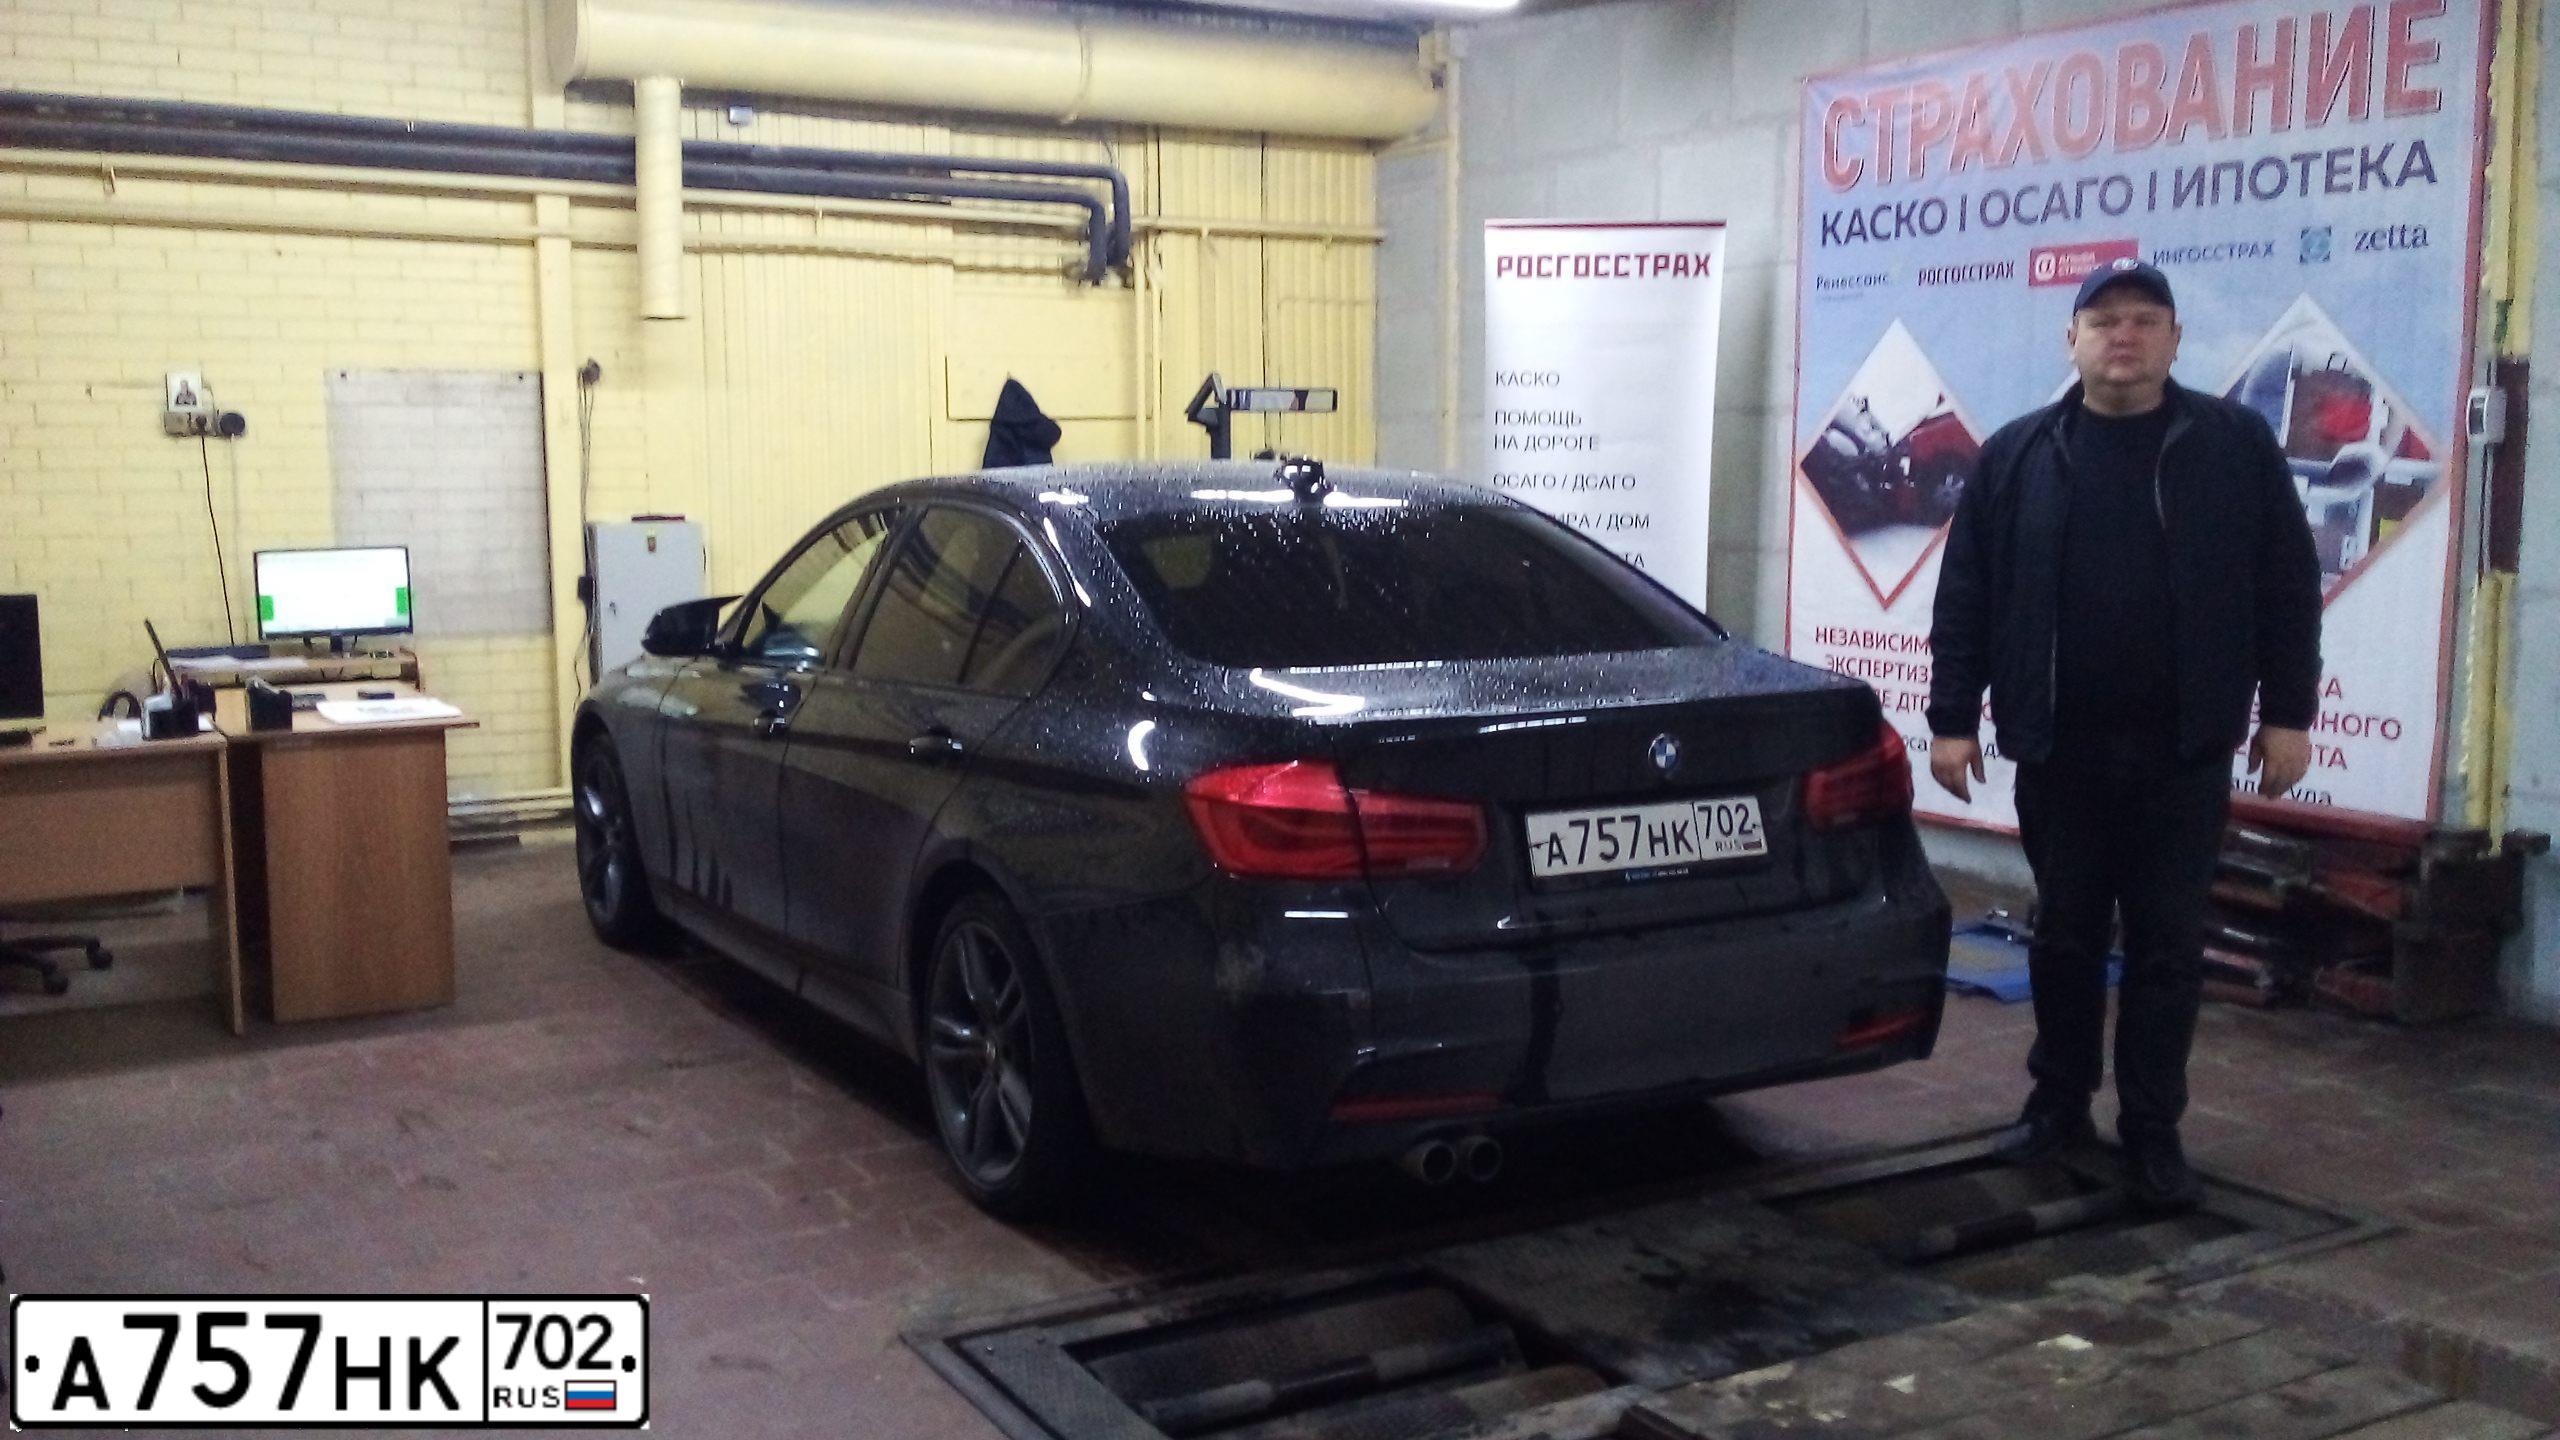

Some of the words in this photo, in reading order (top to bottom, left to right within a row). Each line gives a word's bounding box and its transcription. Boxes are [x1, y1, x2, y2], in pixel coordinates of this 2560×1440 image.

[1821, 0, 2446, 193] СТРАХОВАНИЕ
[1820, 197, 1948, 248] КАСКО
[1979, 176, 2133, 229] ОСАГО
[2171, 138, 2438, 208] ИПОТЕКА
[2354, 223, 2430, 252] zetta
[1497, 252, 1711, 279] РОСГОССТРАХ
[2152, 239, 2275, 267] ИНГОССТРАХ
[1918, 260, 2014, 287] РОСГОССТРАХ
[1494, 369, 1560, 388] КАСКО
[1494, 408, 1582, 429] ПОМОЩЬ
[1493, 433, 1519, 452] НА
[1523, 434, 1600, 454] ДОРОГЕ
[1493, 471, 1556, 490] ОСАГО
[1571, 473, 1636, 493] ДСАГО
[1606, 513, 1650, 532] ДОМ
[1815, 626, 1931, 656] НЕЗАВИСИМ
[1825, 653, 1929, 684] ЭКСПЕРТИЗ
[1697, 803, 1753, 839] 702
